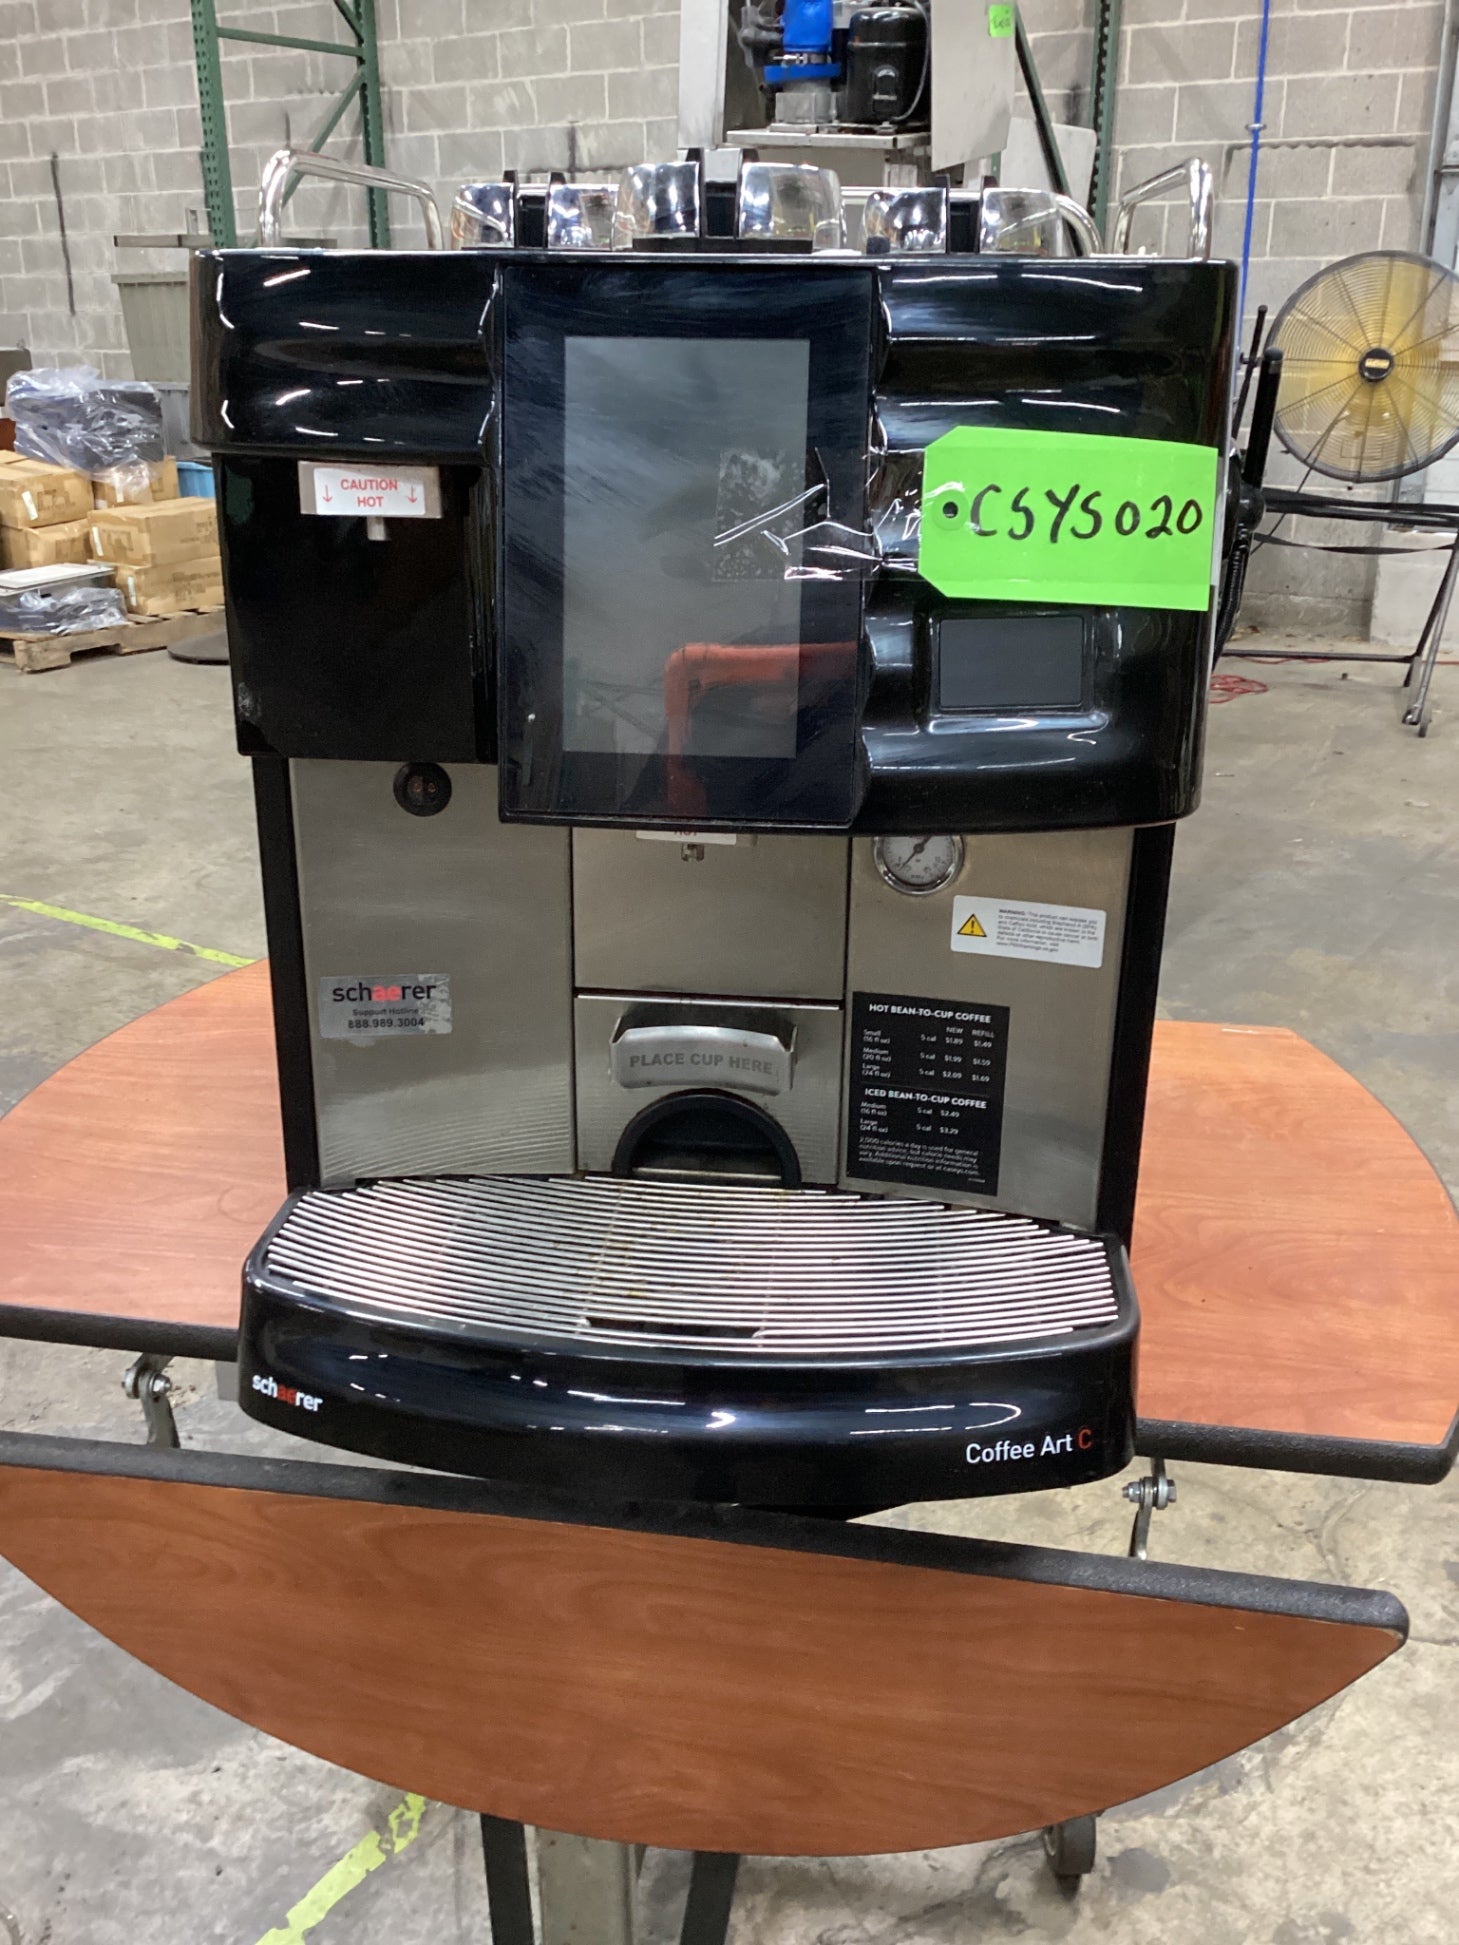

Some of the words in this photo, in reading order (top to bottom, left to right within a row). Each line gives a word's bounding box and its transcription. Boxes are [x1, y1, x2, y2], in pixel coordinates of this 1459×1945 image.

[340, 478, 398, 491] CAUTION
[357, 496, 384, 507] HOT
[970, 483, 1203, 544] CSYS020
[332, 982, 437, 1002] schaerer
[352, 1008, 387, 1017] Support
[389, 1007, 419, 1016] Hotline
[869, 1004, 889, 1013] HOT
[891, 1006, 953, 1018] BEAN-TO-CUP
[955, 1012, 992, 1023] COFFEE
[972, 1029, 994, 1038] REFILL
[863, 1047, 889, 1055] Medium
[629, 1052, 685, 1068] PLACE
[690, 1053, 724, 1067] CUP
[728, 1056, 773, 1075] HERE
[863, 1063, 880, 1071] Large
[860, 1101, 886, 1109] Medium
[865, 1088, 886, 1097] ICED
[888, 1091, 950, 1104] BEAN-TO-CUP
[952, 1097, 987, 1109] COFFEE
[860, 1118, 878, 1126] Large
[252, 1374, 323, 1411] schaerer
[966, 1440, 1035, 1463] Coffee
[1040, 1435, 1072, 1456] Art
[1078, 1428, 1092, 1449] C
